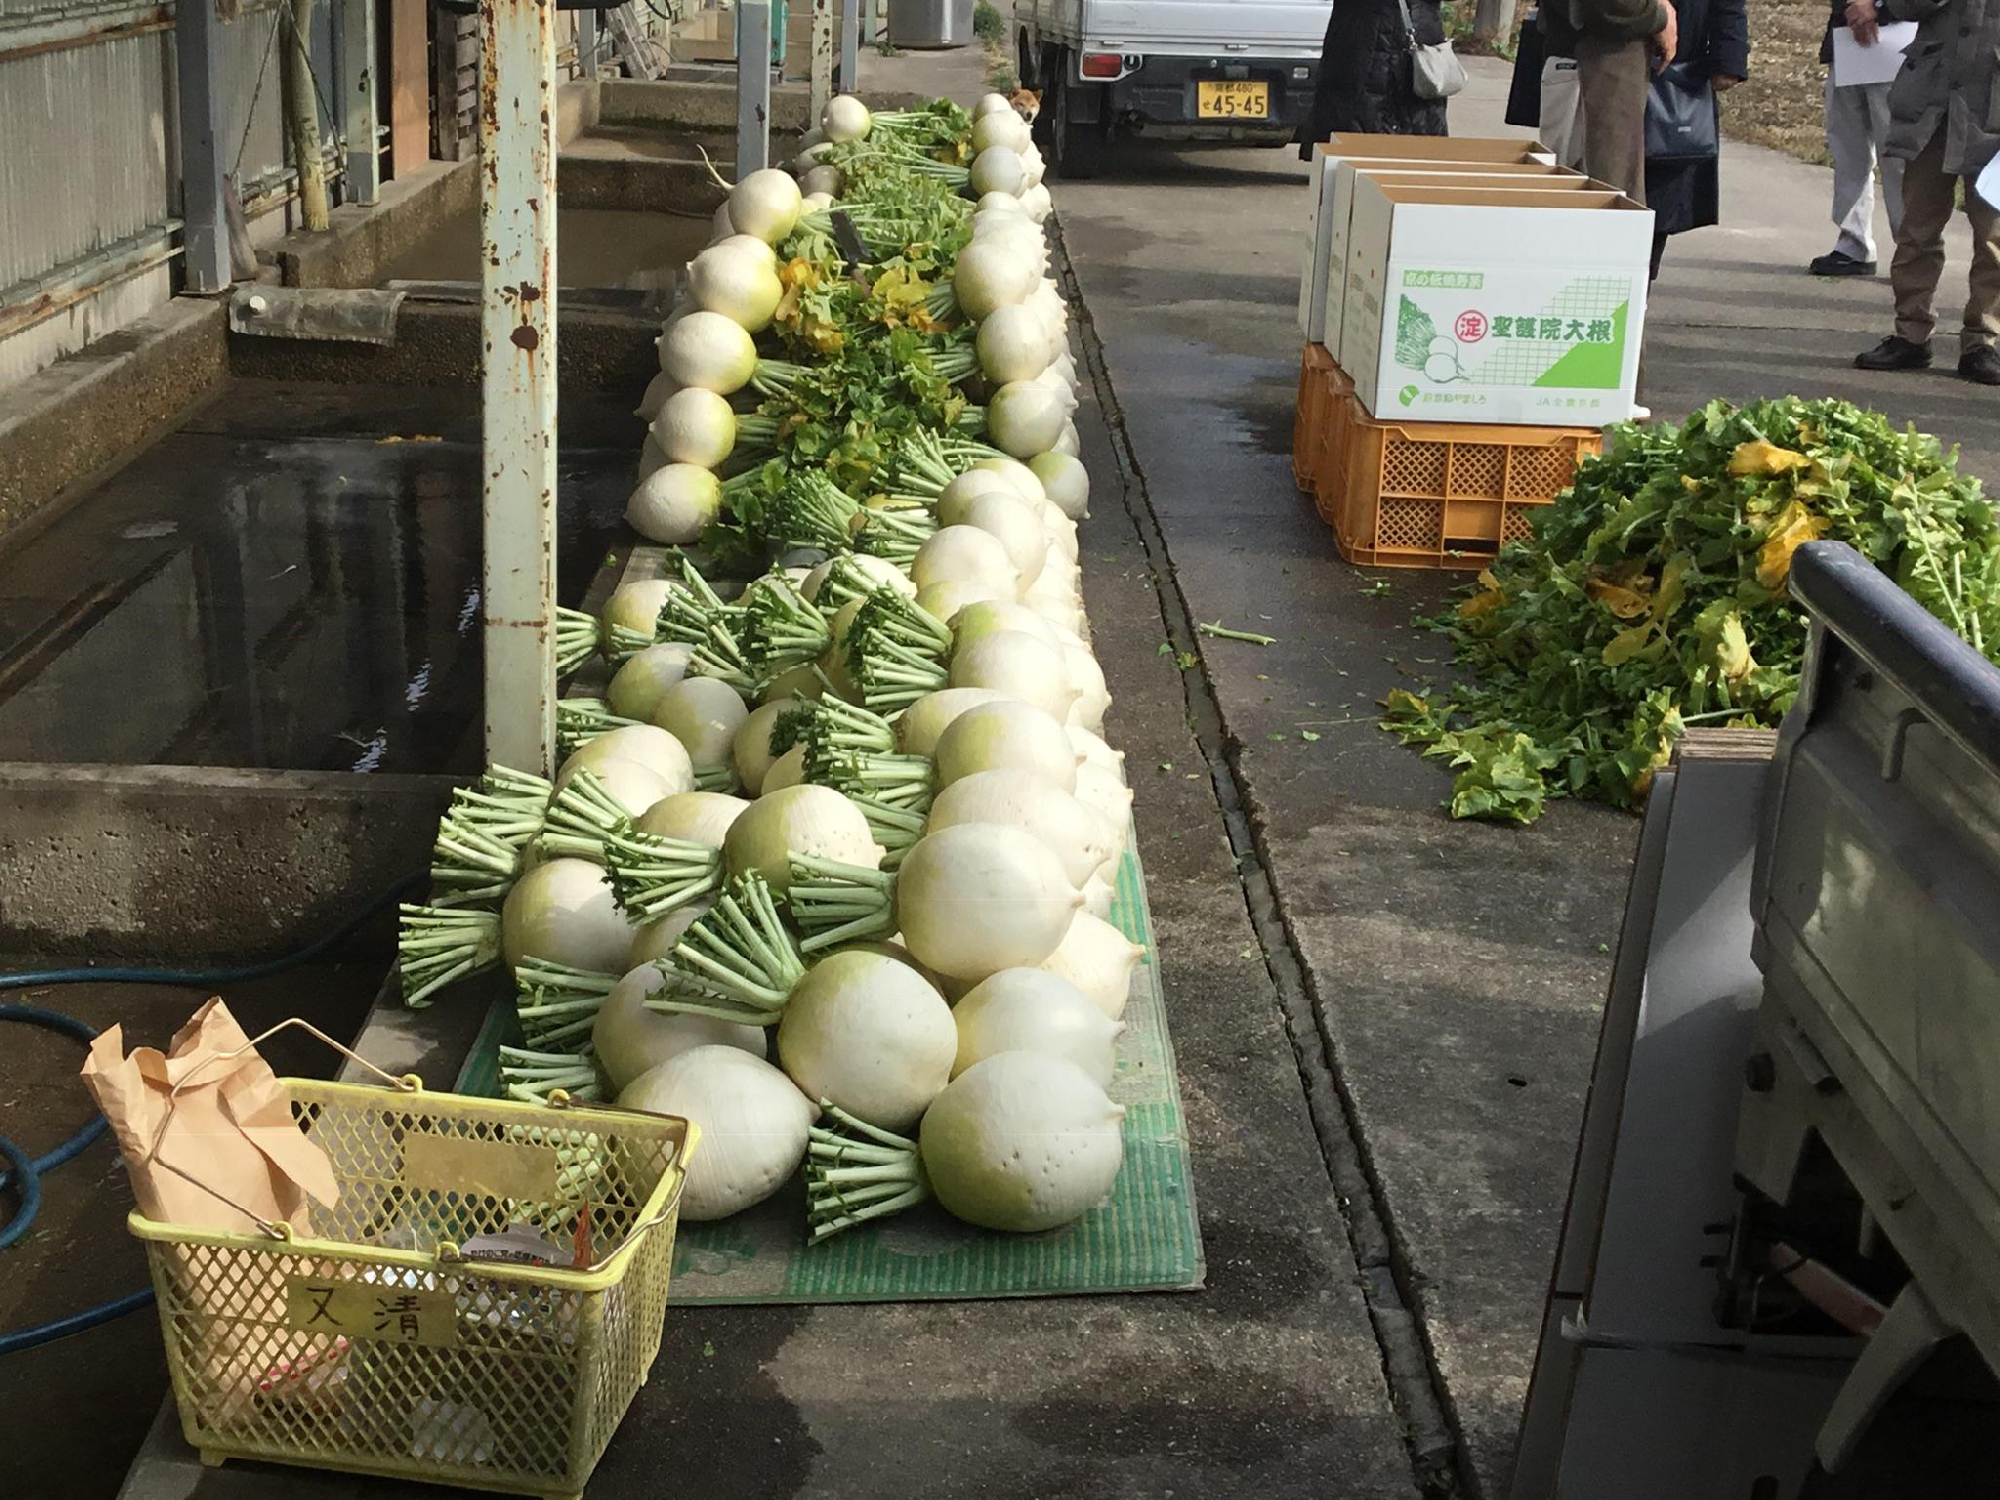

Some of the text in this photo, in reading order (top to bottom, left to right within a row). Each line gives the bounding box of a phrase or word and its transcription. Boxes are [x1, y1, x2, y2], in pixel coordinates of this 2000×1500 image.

[1213, 95, 1265, 114] 45-45
[1459, 315, 1611, 341] 淀 聖護院大根
